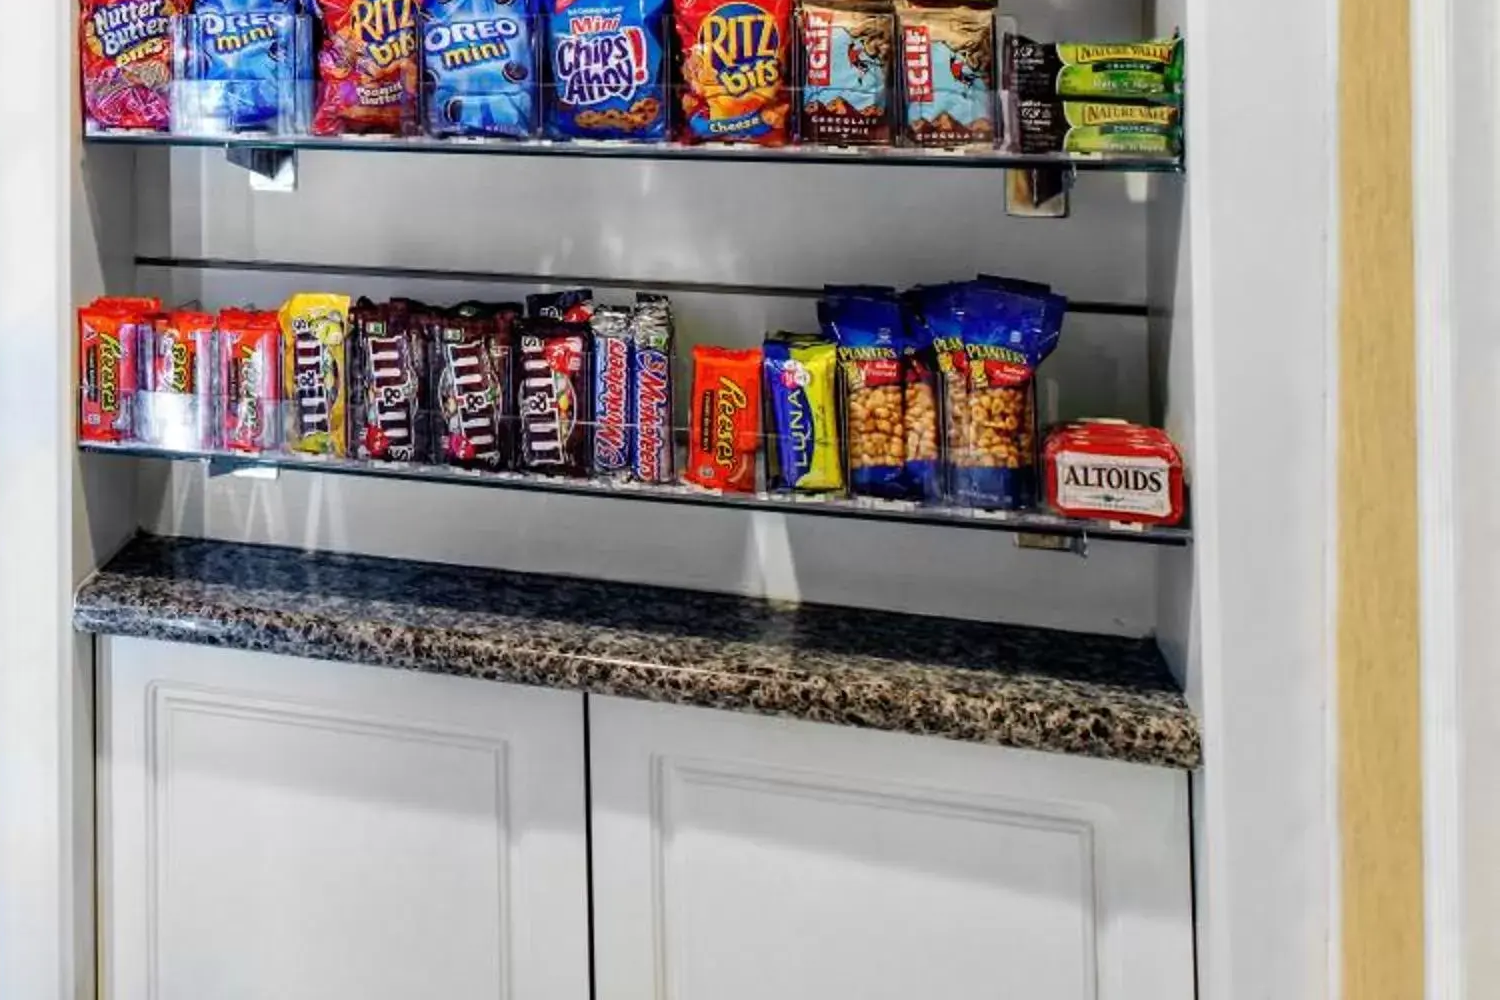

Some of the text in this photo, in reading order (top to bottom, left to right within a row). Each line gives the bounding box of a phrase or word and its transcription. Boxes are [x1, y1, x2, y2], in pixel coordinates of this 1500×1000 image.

[102, 16, 169, 56] Butter
[205, 12, 292, 34] OREO
[216, 24, 275, 51] mini
[425, 19, 518, 50] OREO
[702, 13, 776, 65] RITZ
[443, 38, 507, 68] mini
[556, 35, 629, 80] Chips
[716, 376, 747, 469] Reese's
[787, 389, 810, 468] LUNA
[1063, 466, 1165, 493] ALTOIDS
